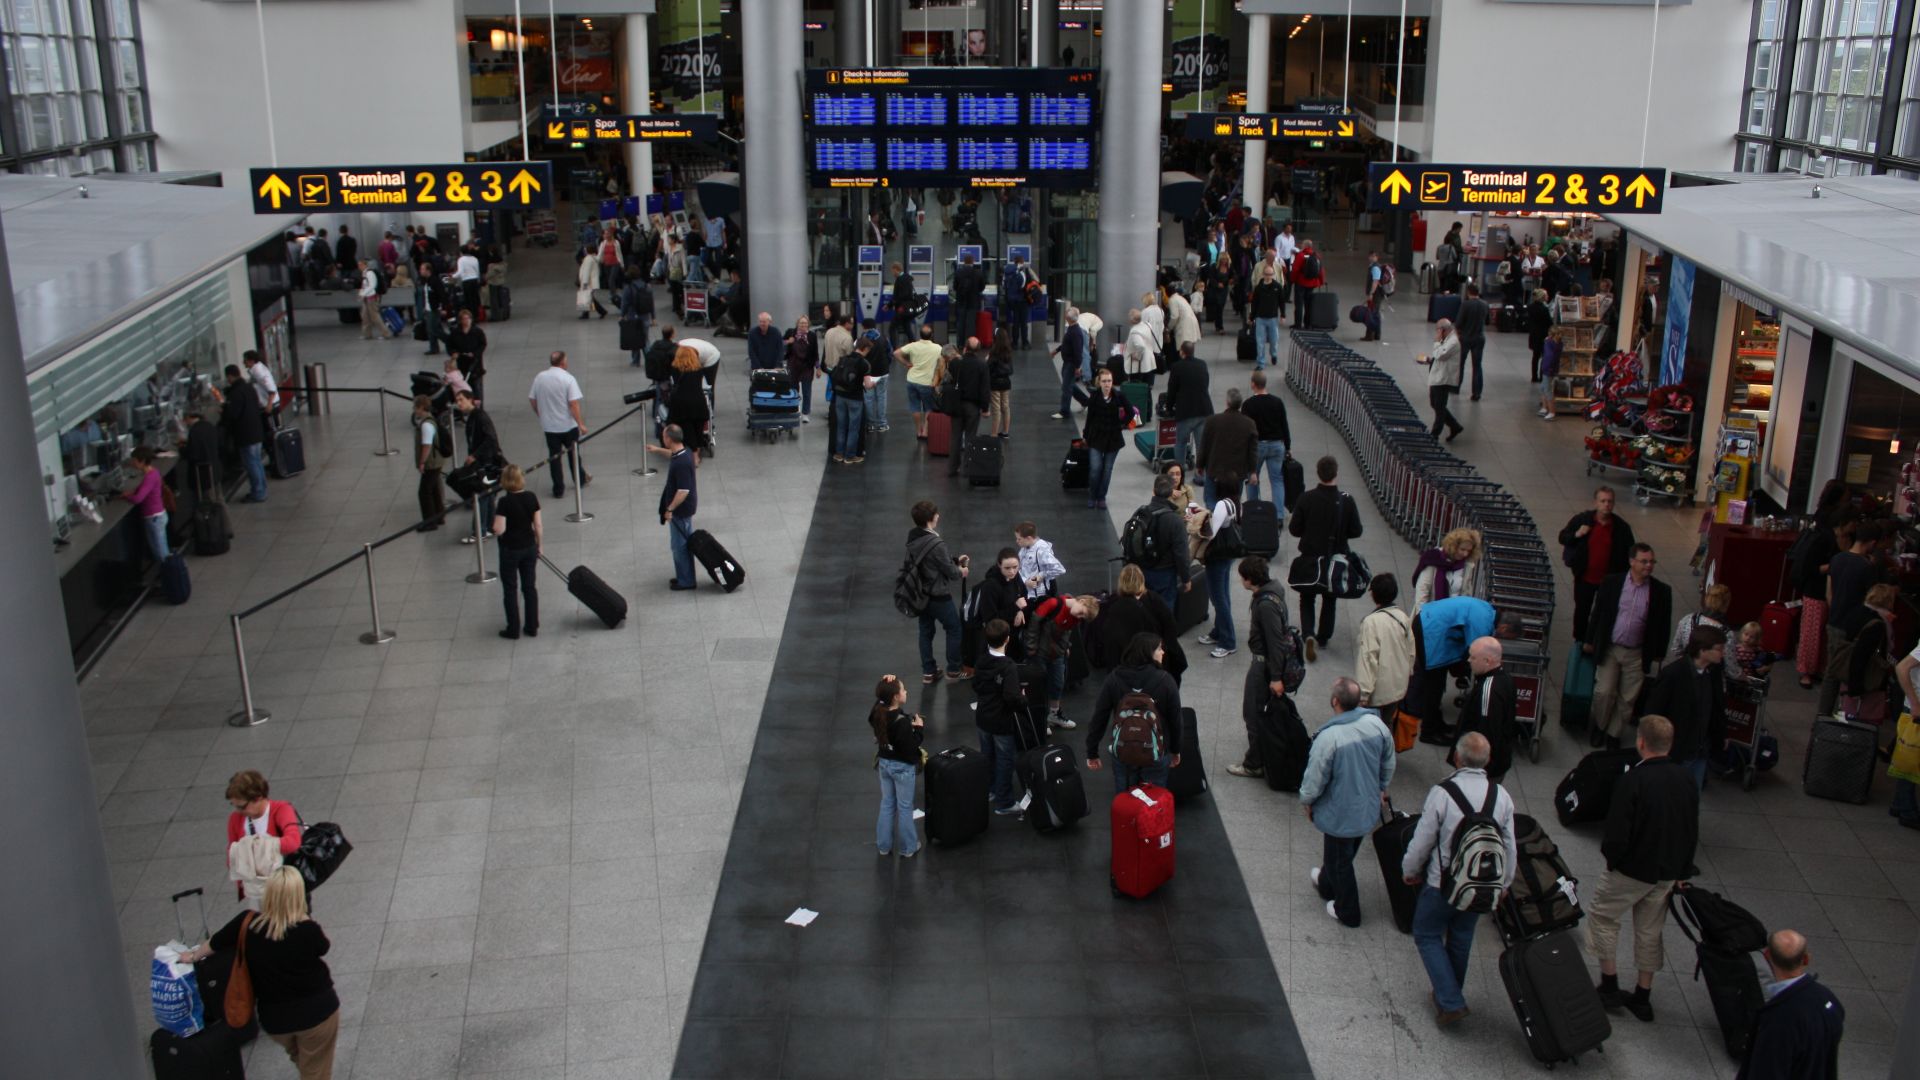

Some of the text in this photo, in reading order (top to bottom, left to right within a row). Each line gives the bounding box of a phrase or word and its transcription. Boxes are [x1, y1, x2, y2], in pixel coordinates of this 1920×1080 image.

[594, 118, 617, 129] Spor
[627, 120, 636, 138] 1
[1238, 116, 1260, 127] Spor
[1270, 118, 1278, 136] 1
[595, 129, 621, 138] Track
[1239, 126, 1264, 136] Track
[339, 171, 406, 187] Terminal
[881, 177, 888, 187] 3
[1463, 170, 1527, 186] Terminal
[415, 171, 503, 203] 2 & 3
[1535, 173, 1619, 205] 2 & 3
[340, 188, 407, 204] Terminal
[1461, 187, 1526, 204] Terminal
